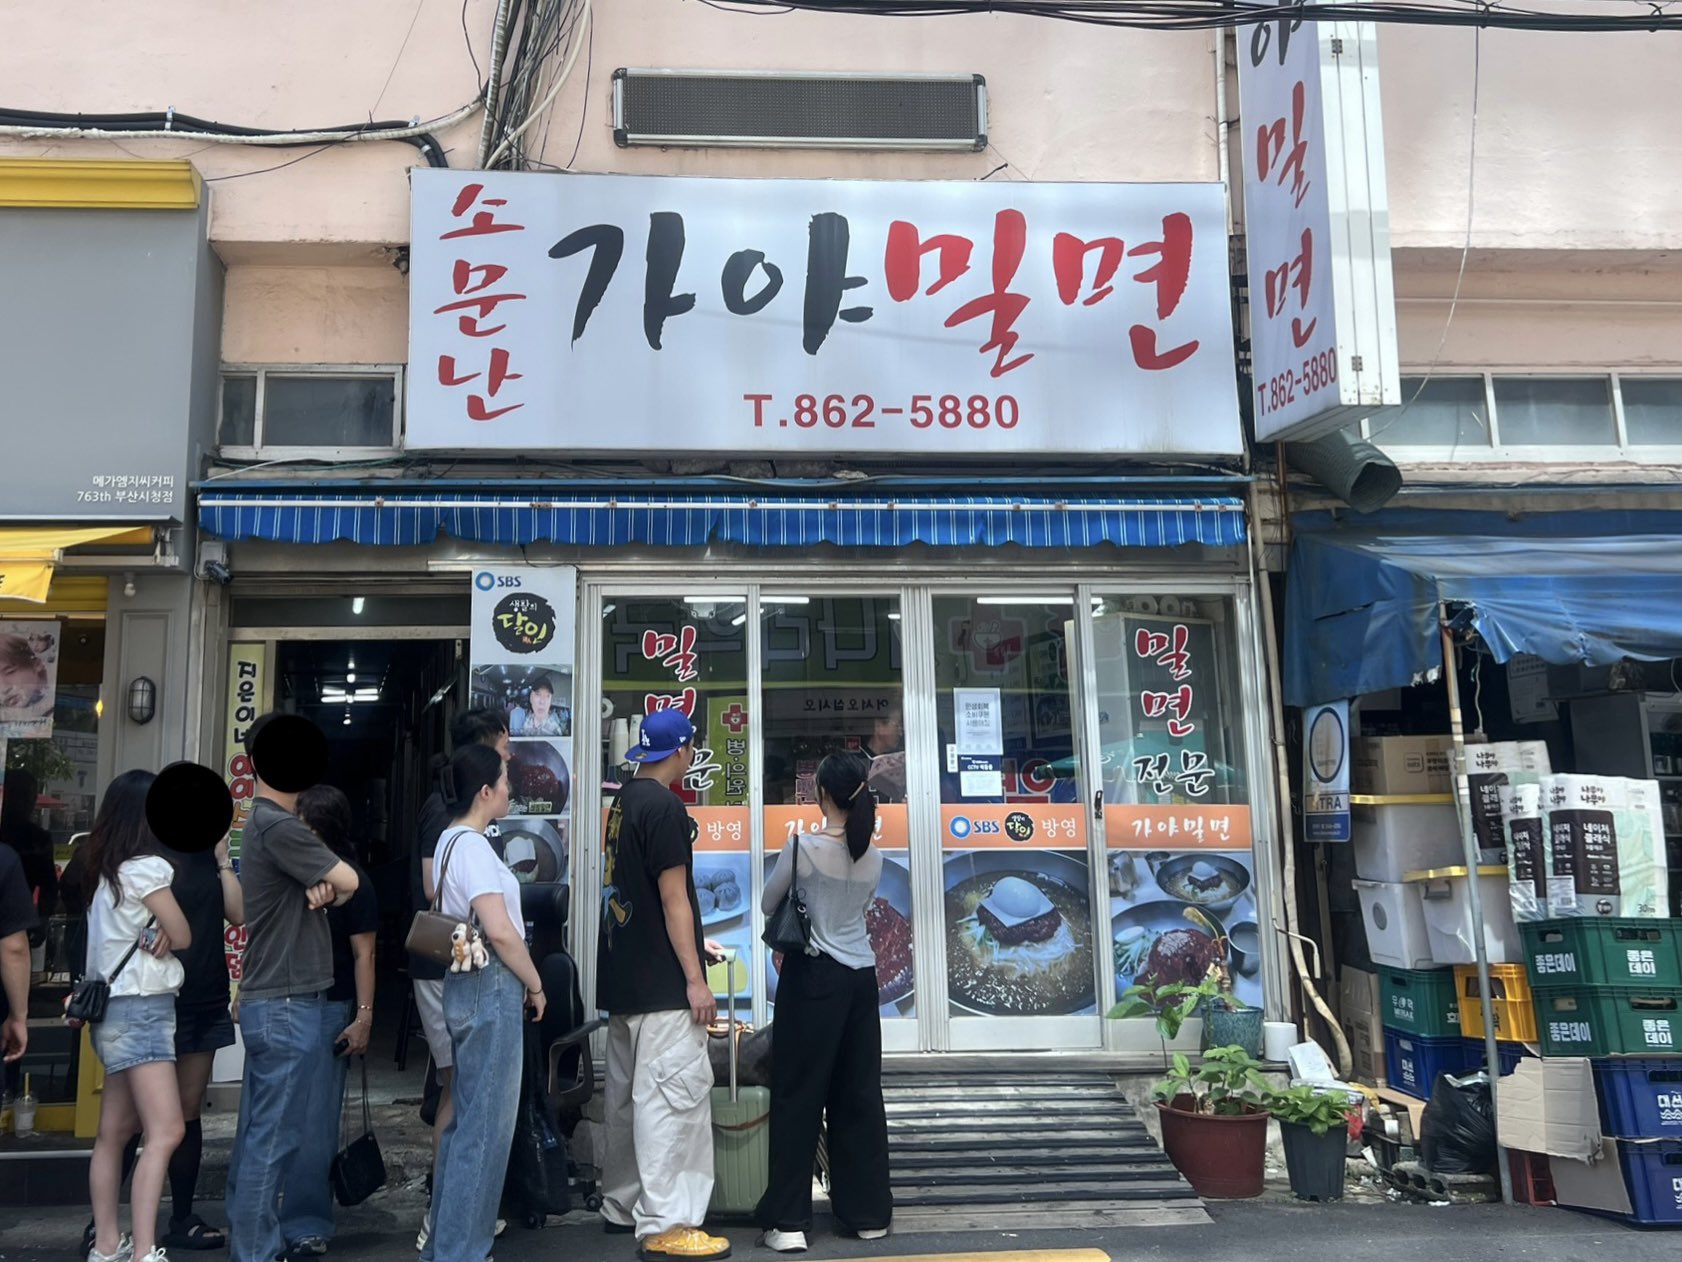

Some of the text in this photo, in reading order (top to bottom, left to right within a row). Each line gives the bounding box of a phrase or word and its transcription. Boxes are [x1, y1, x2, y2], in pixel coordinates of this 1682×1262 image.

[548, 201, 1200, 378] 가야밀면
[433, 183, 527, 421] 소문난
[1258, 347, 1338, 417] T.862-5880
[743, 393, 1020, 430] T.862-5880
[77, 490, 173, 503] 763th 부산시청점
[496, 575, 522, 588] SBS
[509, 599, 538, 613] 생활의
[496, 611, 547, 645] 달인
[1136, 624, 1195, 737] 밀면
[1133, 749, 1215, 796] 전문
[707, 820, 742, 841] 방영
[973, 820, 1000, 833] SBS
[1041, 818, 1077, 838] 방영
[1131, 815, 1230, 844] 가야밀면
[1535, 952, 1577, 974] 좋은데이
[1628, 960, 1656, 975] 데이
[1549, 1021, 1592, 1043] 좋은데이
[1644, 1030, 1673, 1044] 데이
